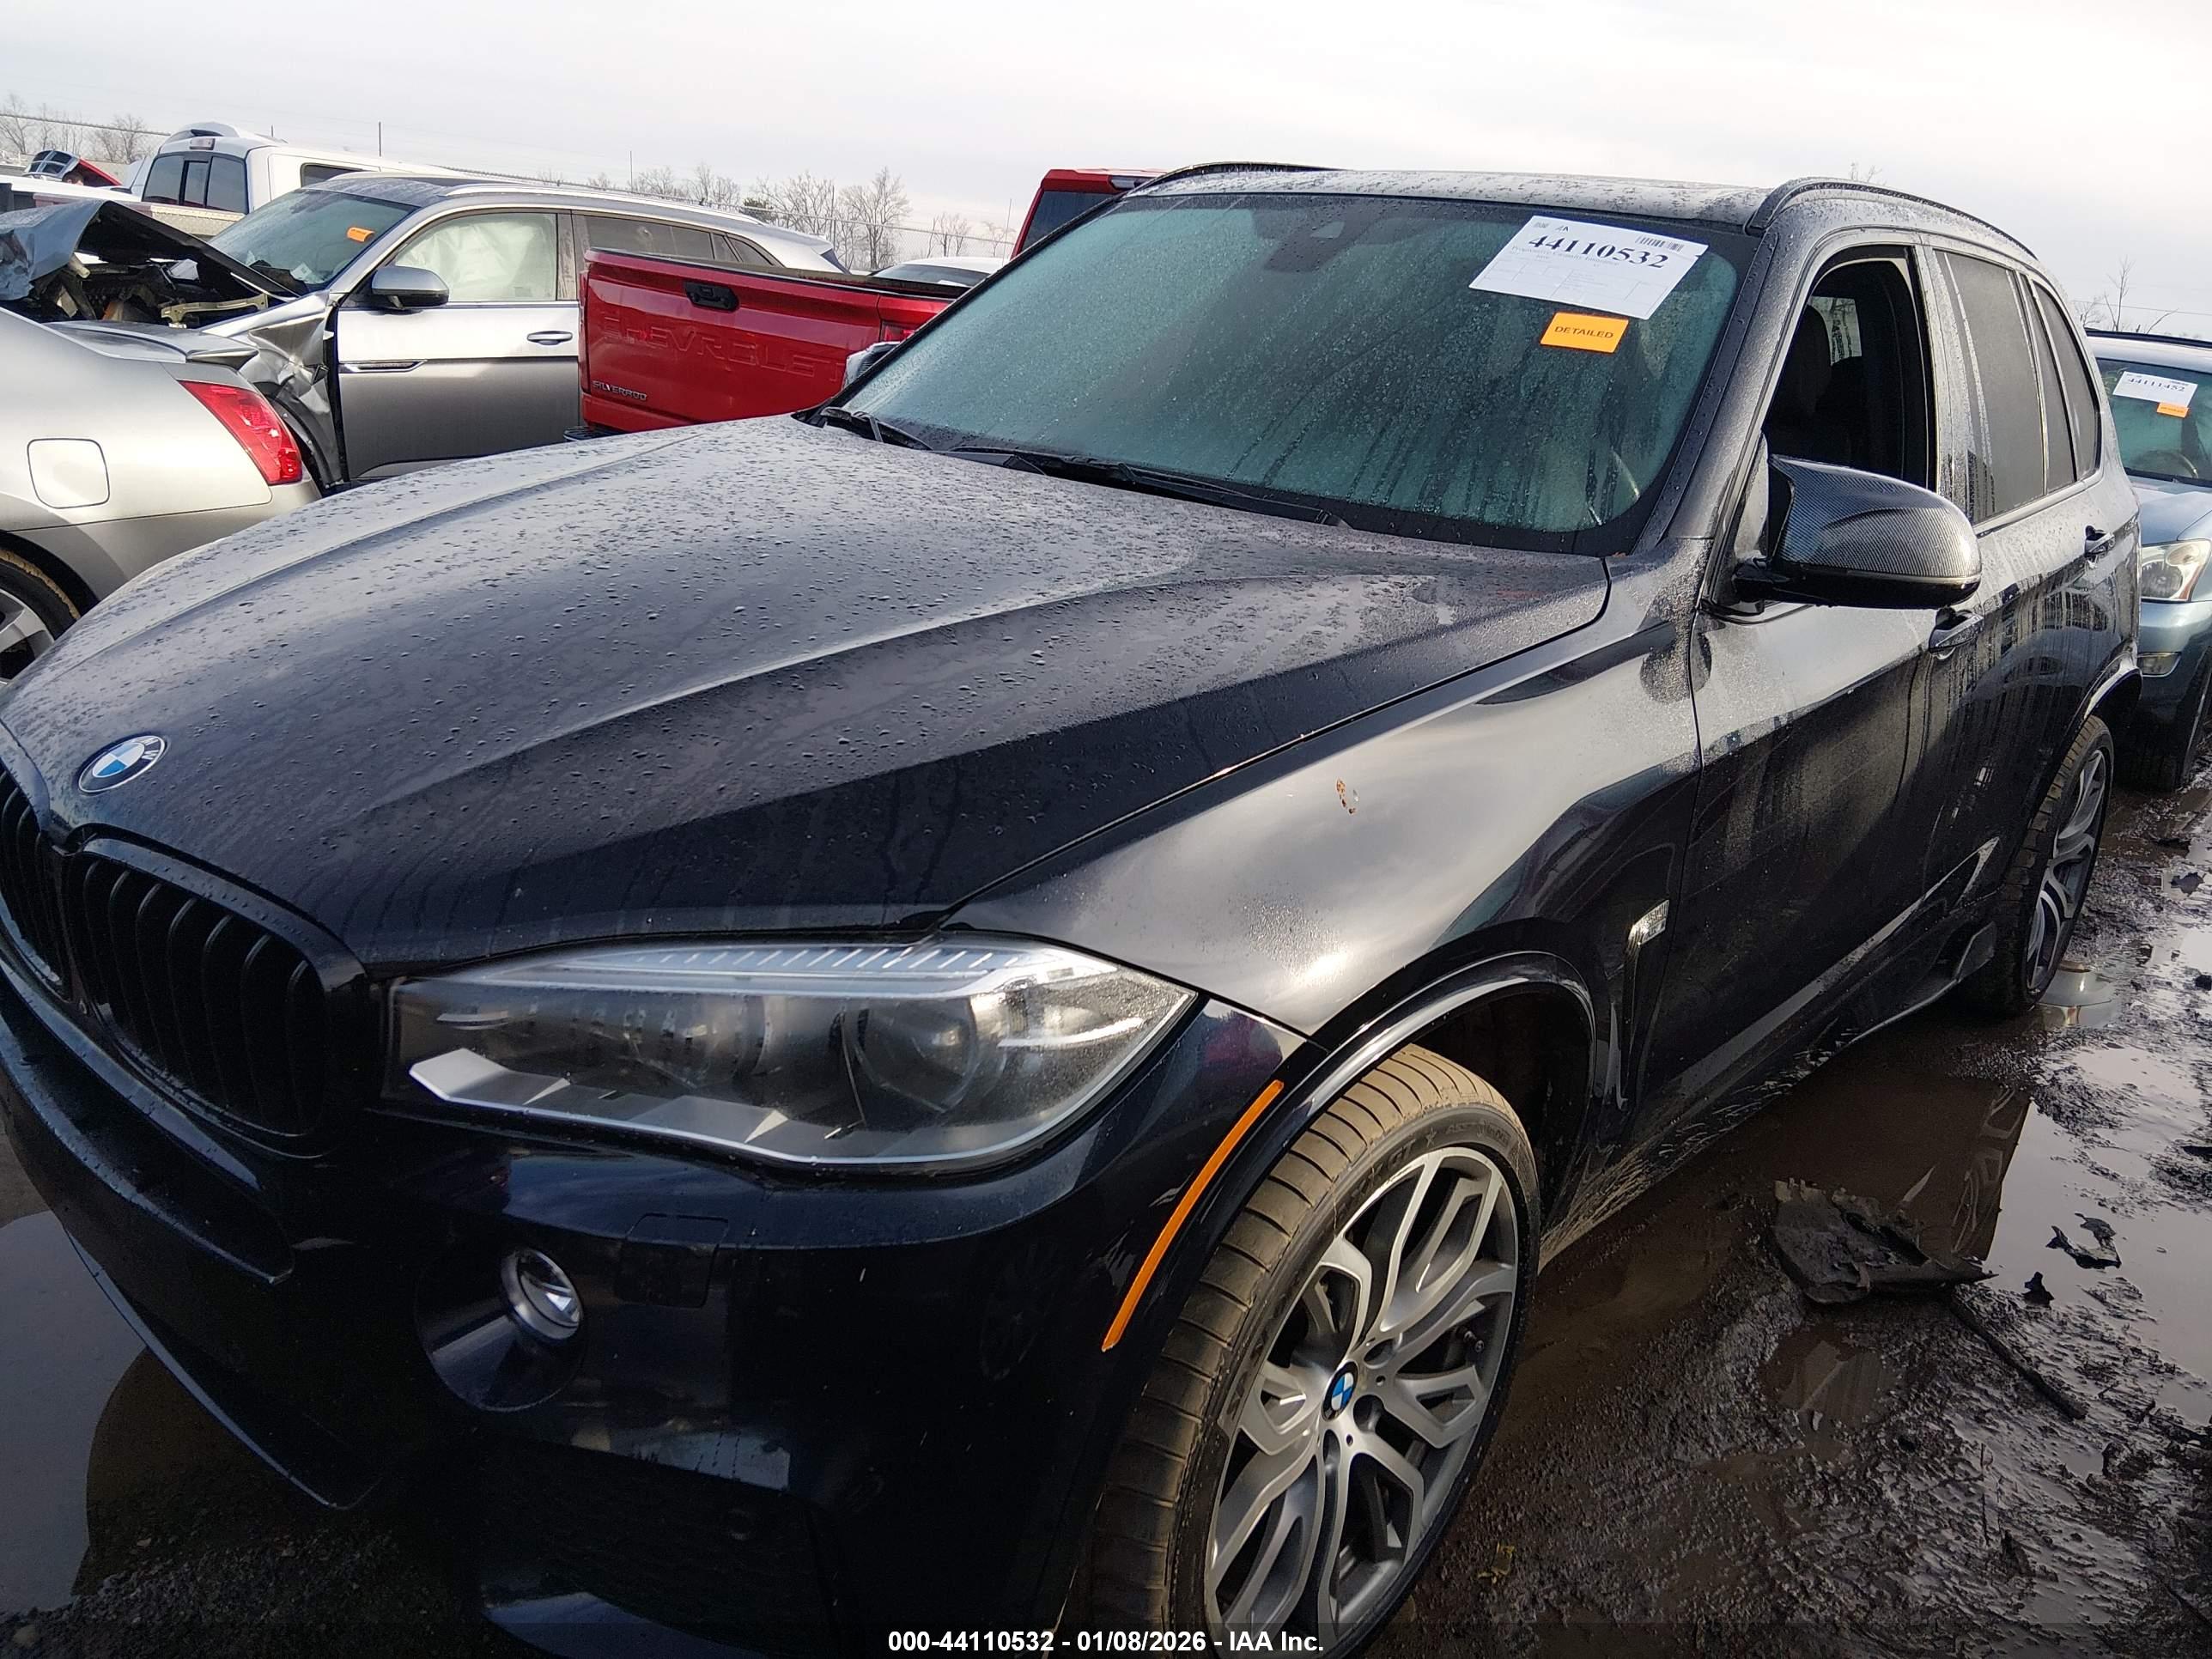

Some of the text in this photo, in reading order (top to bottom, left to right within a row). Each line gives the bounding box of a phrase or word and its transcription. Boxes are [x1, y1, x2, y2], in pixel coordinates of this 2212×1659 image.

[1528, 235, 1669, 269] 44110532
[1554, 325, 1614, 338] DETAILED
[592, 380, 647, 401] SILVERADO
